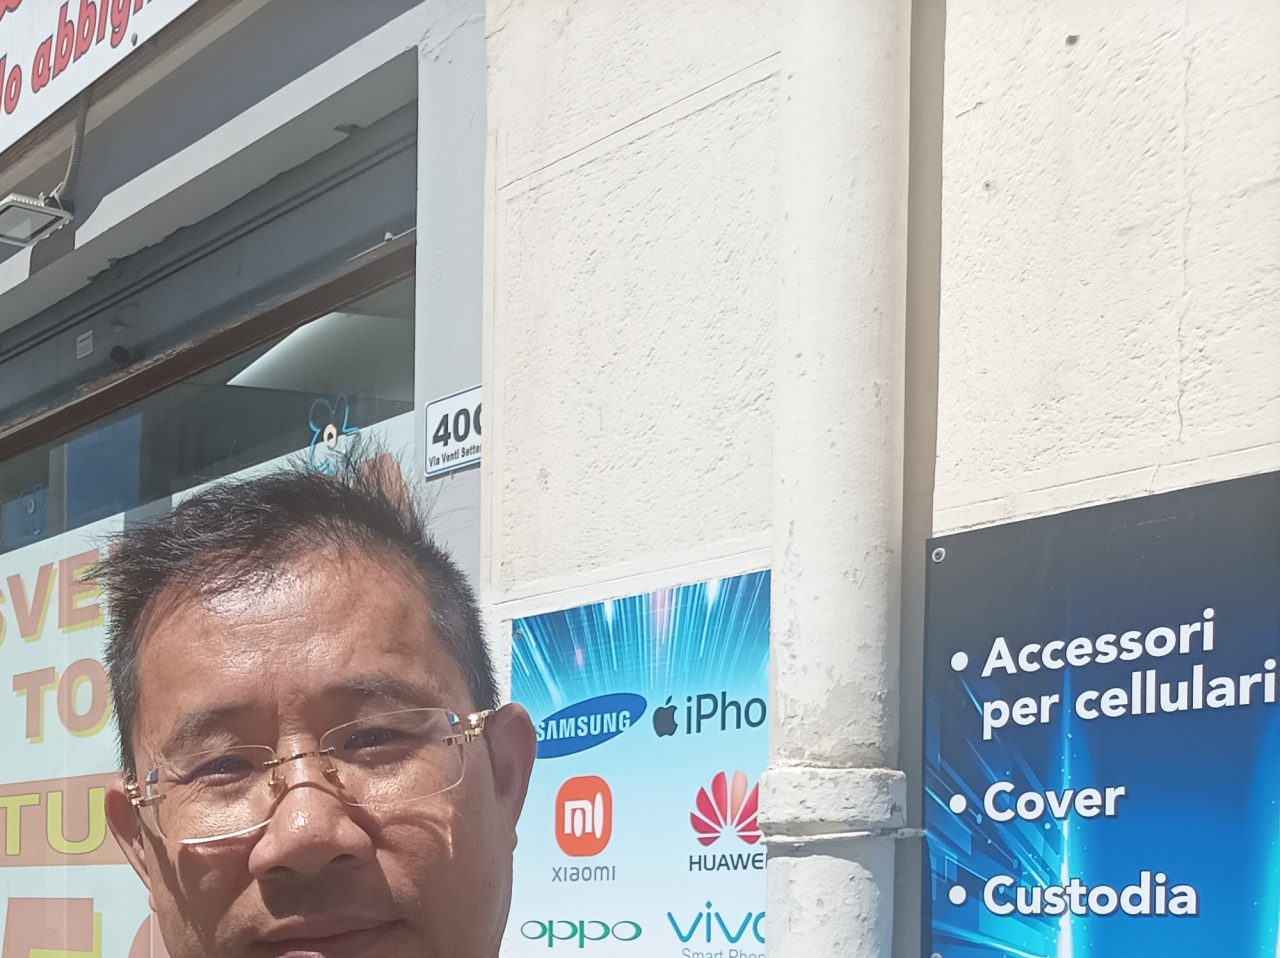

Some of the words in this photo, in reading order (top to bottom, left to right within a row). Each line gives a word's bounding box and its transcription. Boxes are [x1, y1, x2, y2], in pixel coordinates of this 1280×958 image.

[31, 0, 152, 94] abbig
[429, 455, 440, 467] Via
[441, 449, 460, 464] Venti
[461, 444, 482, 458] Sette
[980, 607, 1215, 678] Accessori
[685, 691, 767, 735] iPho
[982, 693, 1060, 741] per
[1075, 657, 1277, 720] cellulari
[535, 710, 632, 742] SAMSUNG
[983, 781, 1126, 822] Cover
[983, 870, 1198, 915] Custodia
